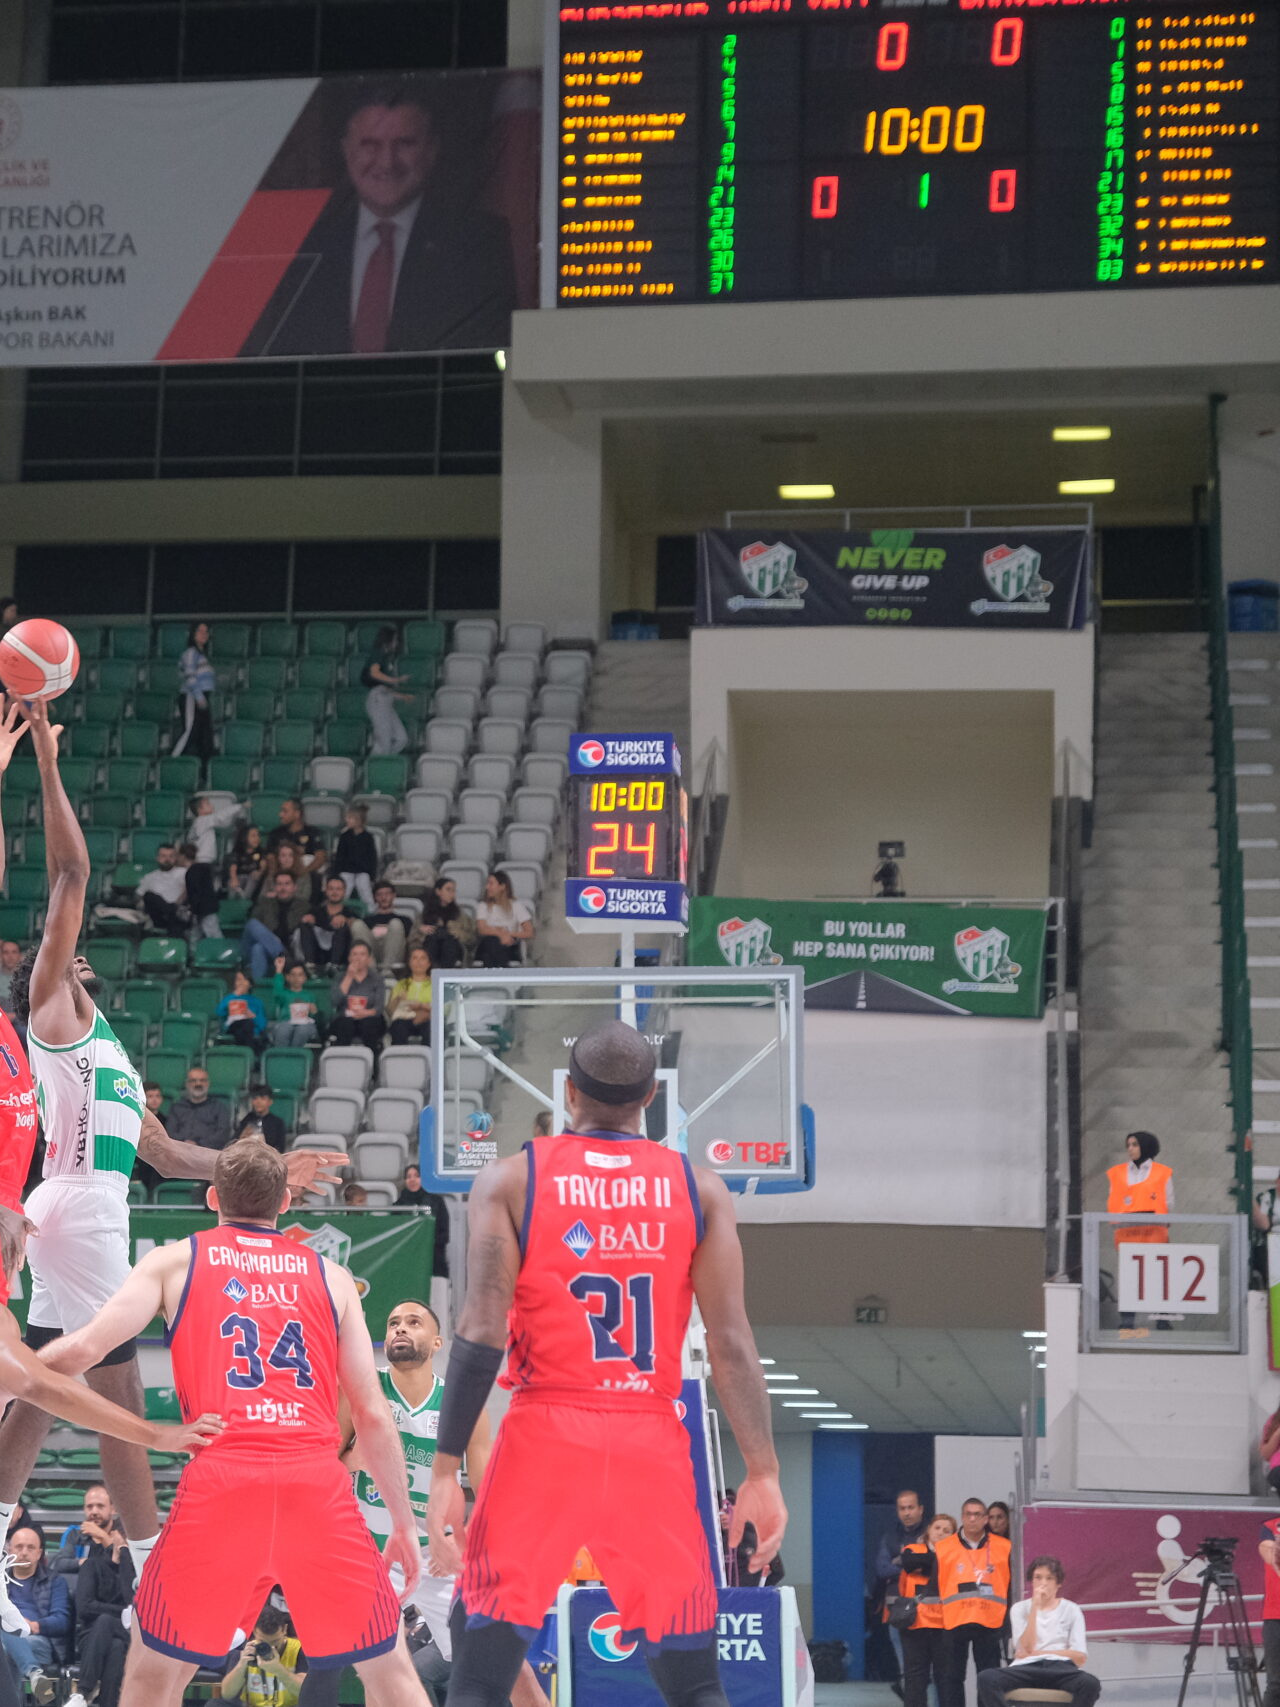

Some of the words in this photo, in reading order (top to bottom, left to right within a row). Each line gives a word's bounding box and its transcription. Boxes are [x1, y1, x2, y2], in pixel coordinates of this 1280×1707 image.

[877, 22, 909, 71] 0
[991, 18, 1023, 66] 0
[864, 105, 985, 155] 10:00
[811, 176, 839, 219] 0
[919, 172, 930, 210] 1
[989, 170, 1017, 213] 0
[47, 305, 88, 322] BAK
[38, 330, 115, 349] BAKANI
[836, 546, 947, 570] NEVER
[590, 781, 666, 812] 10:00
[587, 822, 656, 877] 24
[823, 920, 845, 938] BU
[848, 921, 907, 939] YOLLAR
[792, 941, 824, 959] HEP
[826, 942, 867, 960] SANA
[736, 1141, 790, 1164] TBF
[554, 1175, 647, 1210] TAYLOR
[655, 1176, 671, 1208] II
[598, 1221, 667, 1252] BAU
[208, 1246, 309, 1276] CAVANAUGH
[250, 1283, 300, 1305] BAU
[1131, 1254, 1208, 1302] 112
[568, 1271, 656, 1375] 21
[221, 1312, 315, 1390] 34
[246, 1398, 304, 1423] uğur
